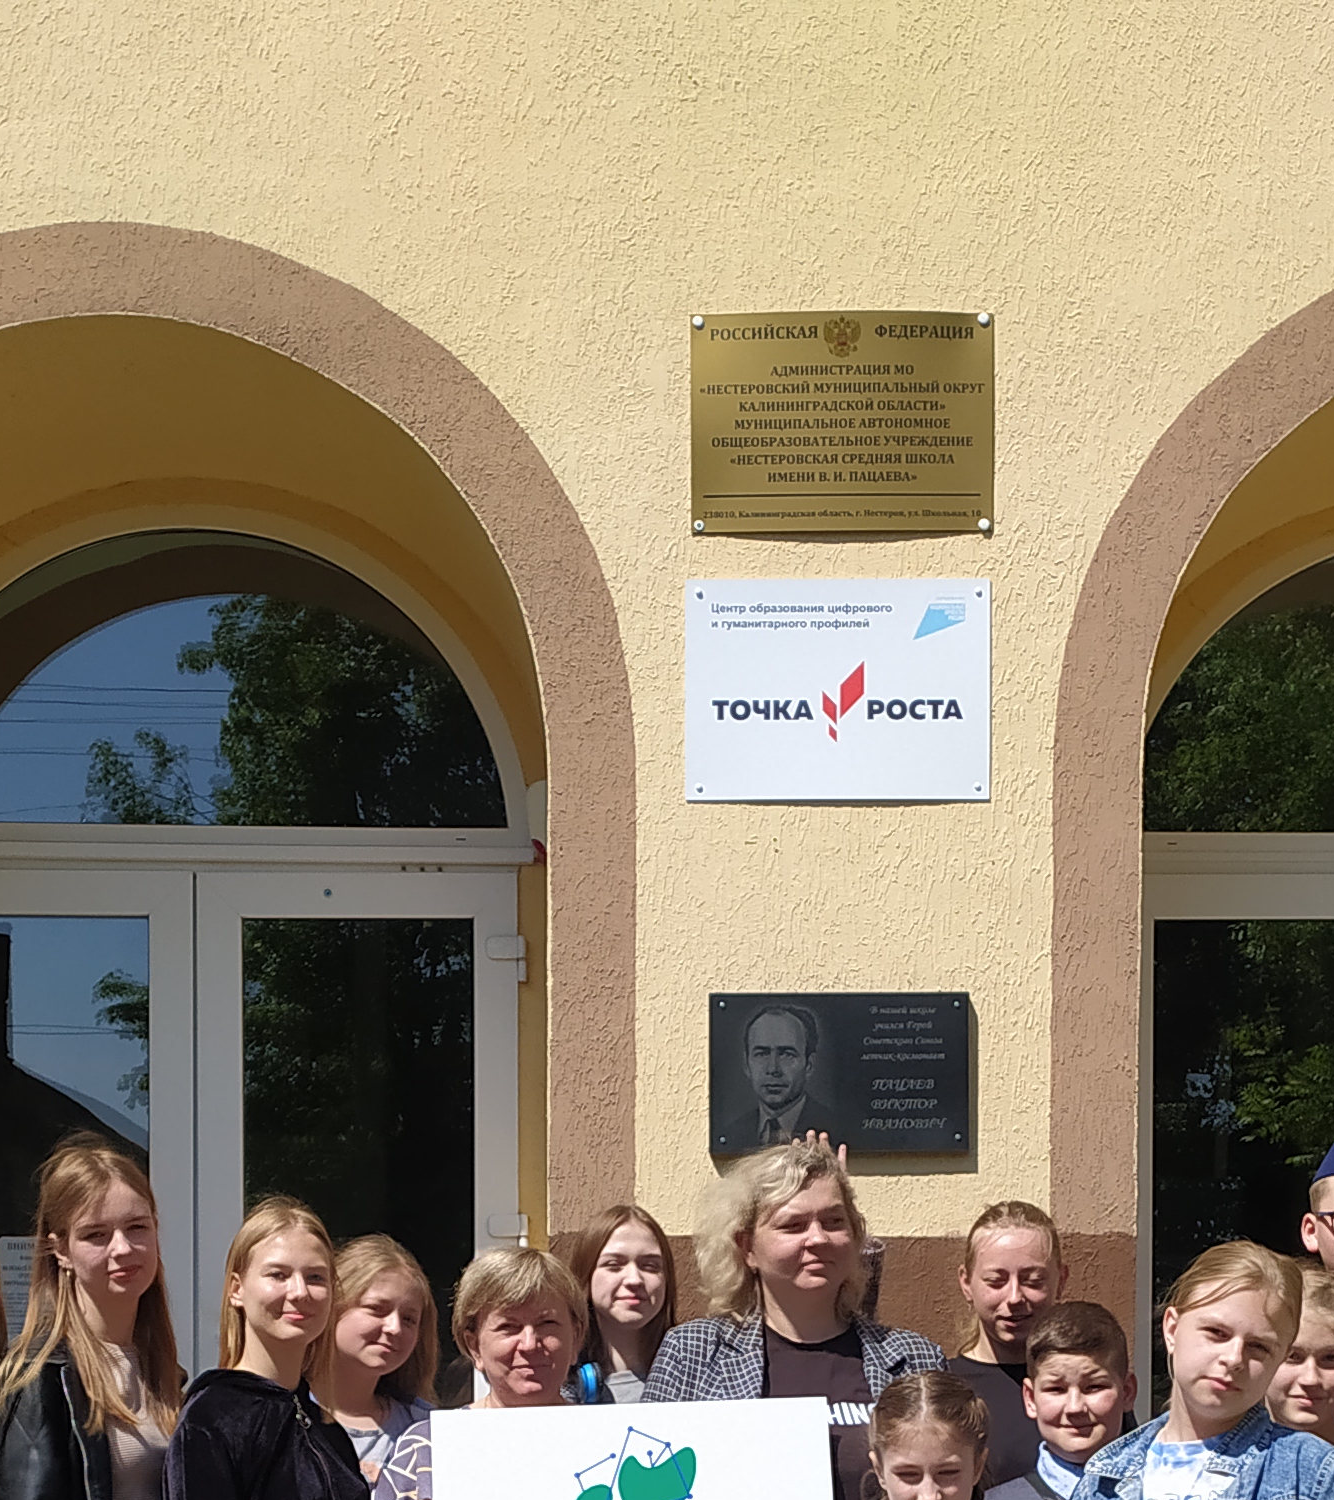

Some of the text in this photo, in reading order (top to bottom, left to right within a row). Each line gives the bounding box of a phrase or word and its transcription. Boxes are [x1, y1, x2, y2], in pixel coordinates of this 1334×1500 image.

[710, 324, 974, 341] РОССИЙСКАЯ ФЕДЕРАЦИЯ
[770, 365, 914, 378] АДМИНИСТРАЦИЯ МО
[699, 381, 985, 395] «НЕСТЕРОВСКИЙ МУНИЦИПАЛЬНЫЙ ОКРУГ
[738, 398, 946, 413] КАЛИНИНГРАДСКОЙ ОБЛАСТИ»
[734, 418, 951, 432] МУНИЦИПАЛЬНОЕ АВТОНОМНОЕ
[711, 435, 974, 449] ОБЩЕОБРАЗОВАТЕЛЬНОЕ УЧРЕЖДЕНИЕ
[730, 453, 955, 467] «НЕСТЕРОВСКАЯ СРЕДНЯЯ ШКОЛА
[767, 471, 917, 484] ИМЕНИ В. И. ПАЦАЕВА»
[738, 511, 816, 519] Калининградская
[711, 603, 893, 616] Центр образования цифрового
[711, 618, 870, 631] и гуманитарного профилей
[712, 699, 963, 720] ТОЧКА РОСТА
[872, 1079, 935, 1092] ПАЦАЕВ
[871, 1099, 938, 1111] ВИКТОР
[862, 1117, 947, 1130] ИВАНОВИЧ
[827, 1402, 877, 1426] HIN
